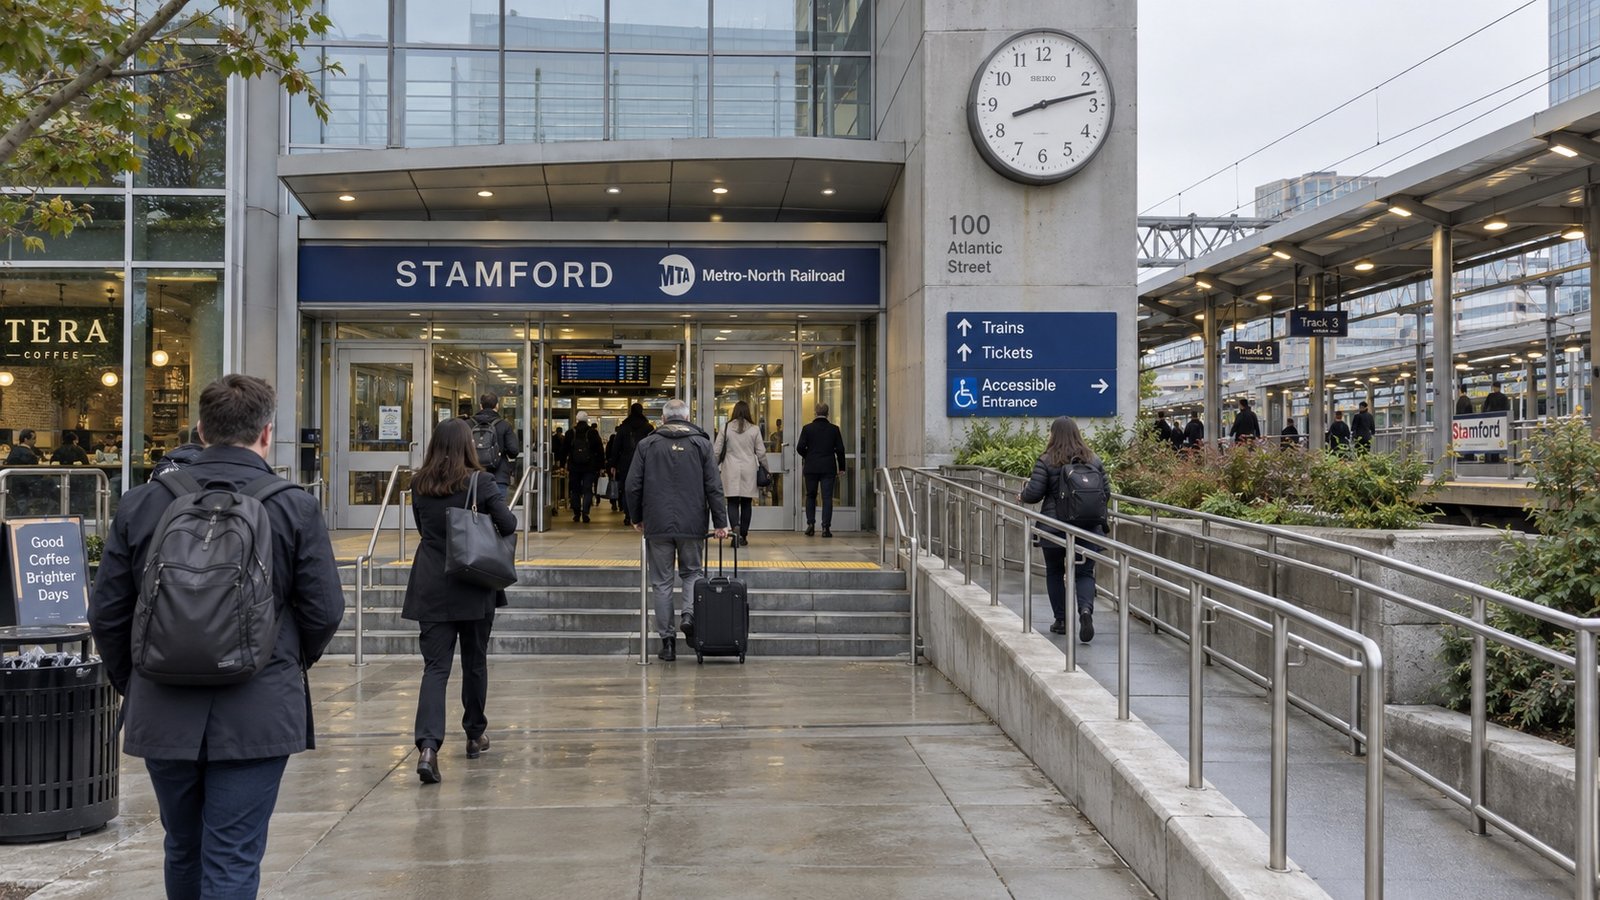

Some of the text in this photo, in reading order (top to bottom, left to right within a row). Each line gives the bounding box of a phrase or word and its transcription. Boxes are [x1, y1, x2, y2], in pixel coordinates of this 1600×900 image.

[1013, 53, 1026, 67] 11
[1035, 47, 1051, 61] 12
[1065, 53, 1071, 67] 1
[996, 72, 1011, 86] 10
[1081, 72, 1090, 86] 2
[988, 97, 997, 112] 9
[1089, 98, 1098, 113] 3
[995, 123, 1005, 138] 8
[1080, 124, 1090, 138] 4
[1014, 142, 1023, 156] 7
[1037, 149, 1047, 163] 6
[1063, 142, 1072, 157] 5
[949, 214, 991, 235] 100
[947, 241, 1003, 254] Atlantic
[947, 259, 991, 273] Street
[396, 260, 613, 288] STAMFORD
[658, 264, 690, 288] MTA
[702, 268, 845, 282] Metro-North Railroad
[982, 321, 1025, 334] Trains
[1300, 316, 1339, 328] Track 3
[4, 319, 109, 343] TERA
[24, 351, 79, 359] COFFEE
[982, 346, 1033, 359] Tickets
[1265, 346, 1273, 356] 3
[982, 378, 1057, 392] Accessible
[982, 395, 1038, 407] Entrance
[1452, 420, 1500, 440] Stamford
[31, 535, 64, 548] Good
[29, 553, 70, 566] Coffee
[26, 571, 76, 585] Brighter
[38, 589, 69, 602] Days
